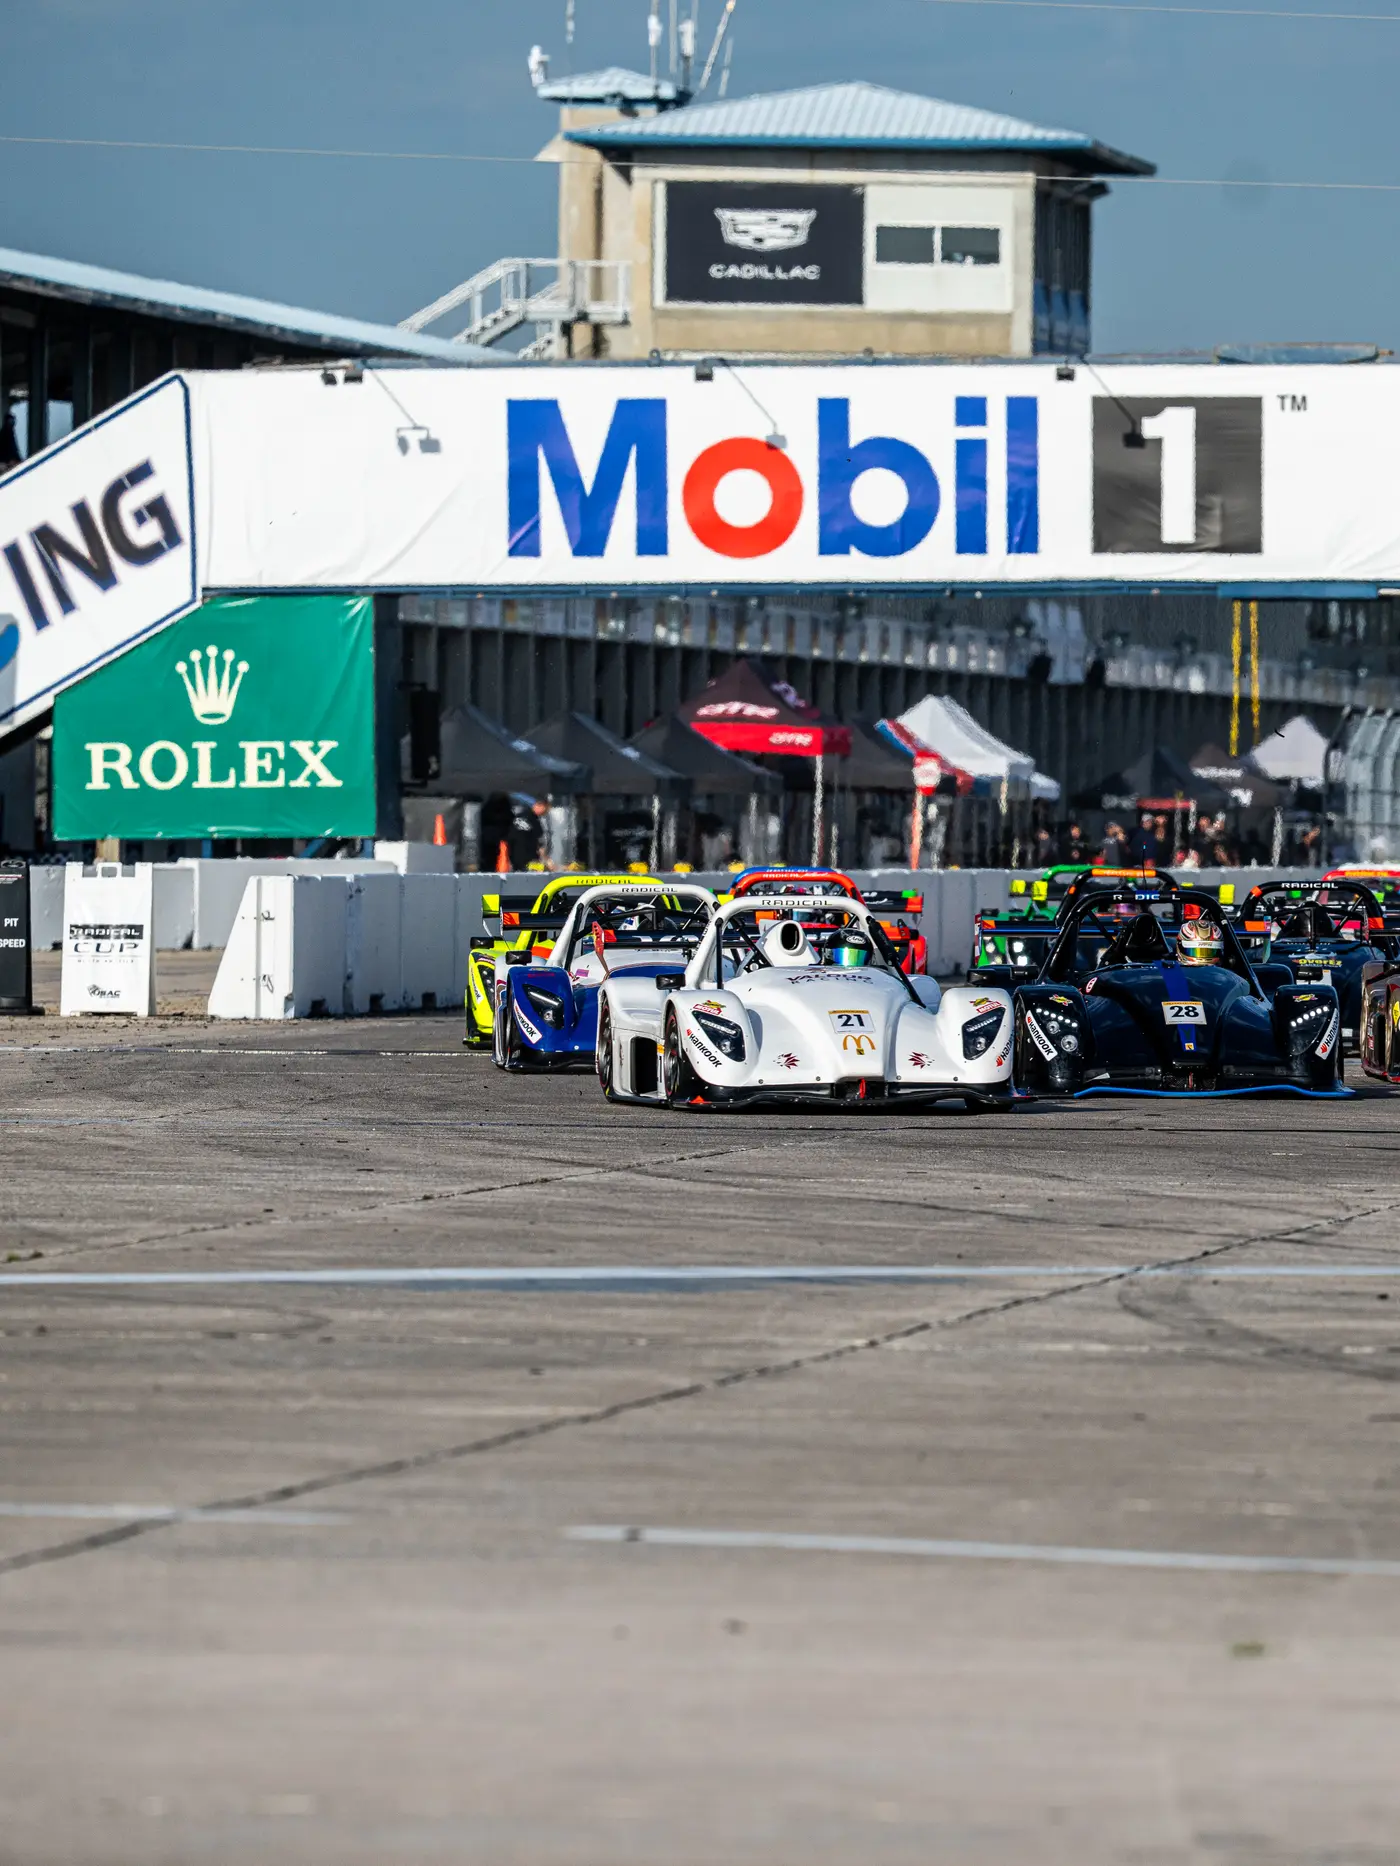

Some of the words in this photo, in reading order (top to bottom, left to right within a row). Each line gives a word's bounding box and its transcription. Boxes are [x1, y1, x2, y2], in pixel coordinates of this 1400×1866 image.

[708, 263, 821, 280] CADILLAC
[506, 397, 1039, 559] Mobil
[1140, 405, 1197, 544] 1
[2, 455, 184, 635] ING
[84, 740, 343, 790] ROLEX
[4, 917, 19, 927] PIT
[73, 942, 140, 953] CUP
[1169, 1005, 1200, 1018] 28
[837, 1014, 865, 1028] 21
